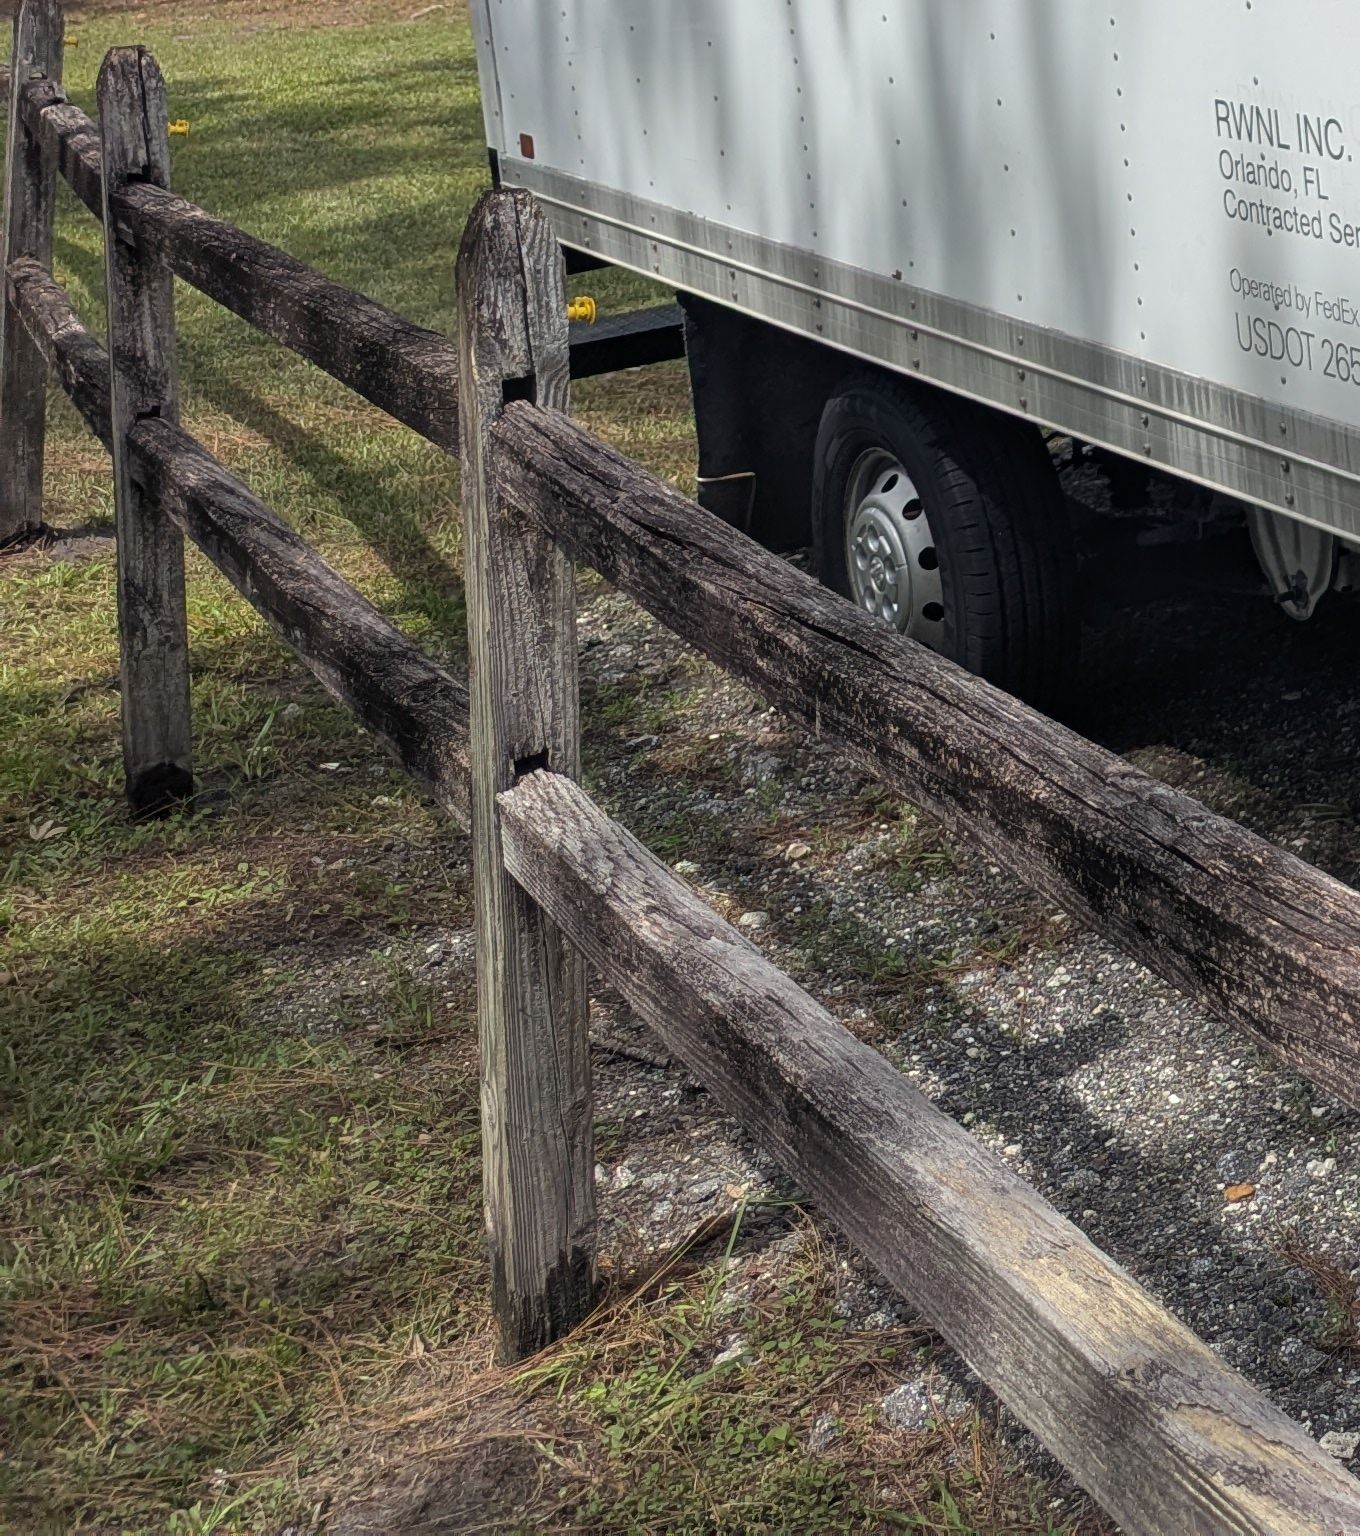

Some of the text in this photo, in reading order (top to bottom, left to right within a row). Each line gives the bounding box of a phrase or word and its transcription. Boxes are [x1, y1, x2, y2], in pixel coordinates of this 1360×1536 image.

[1213, 97, 1353, 162] RWNL INC.
[1218, 149, 1330, 201] Orlando, FL
[1222, 188, 1324, 240] Contracted
[1229, 268, 1292, 310] Operated
[1294, 284, 1312, 319] by
[1314, 291, 1360, 328] FedEx
[1234, 311, 1315, 372] USDOT
